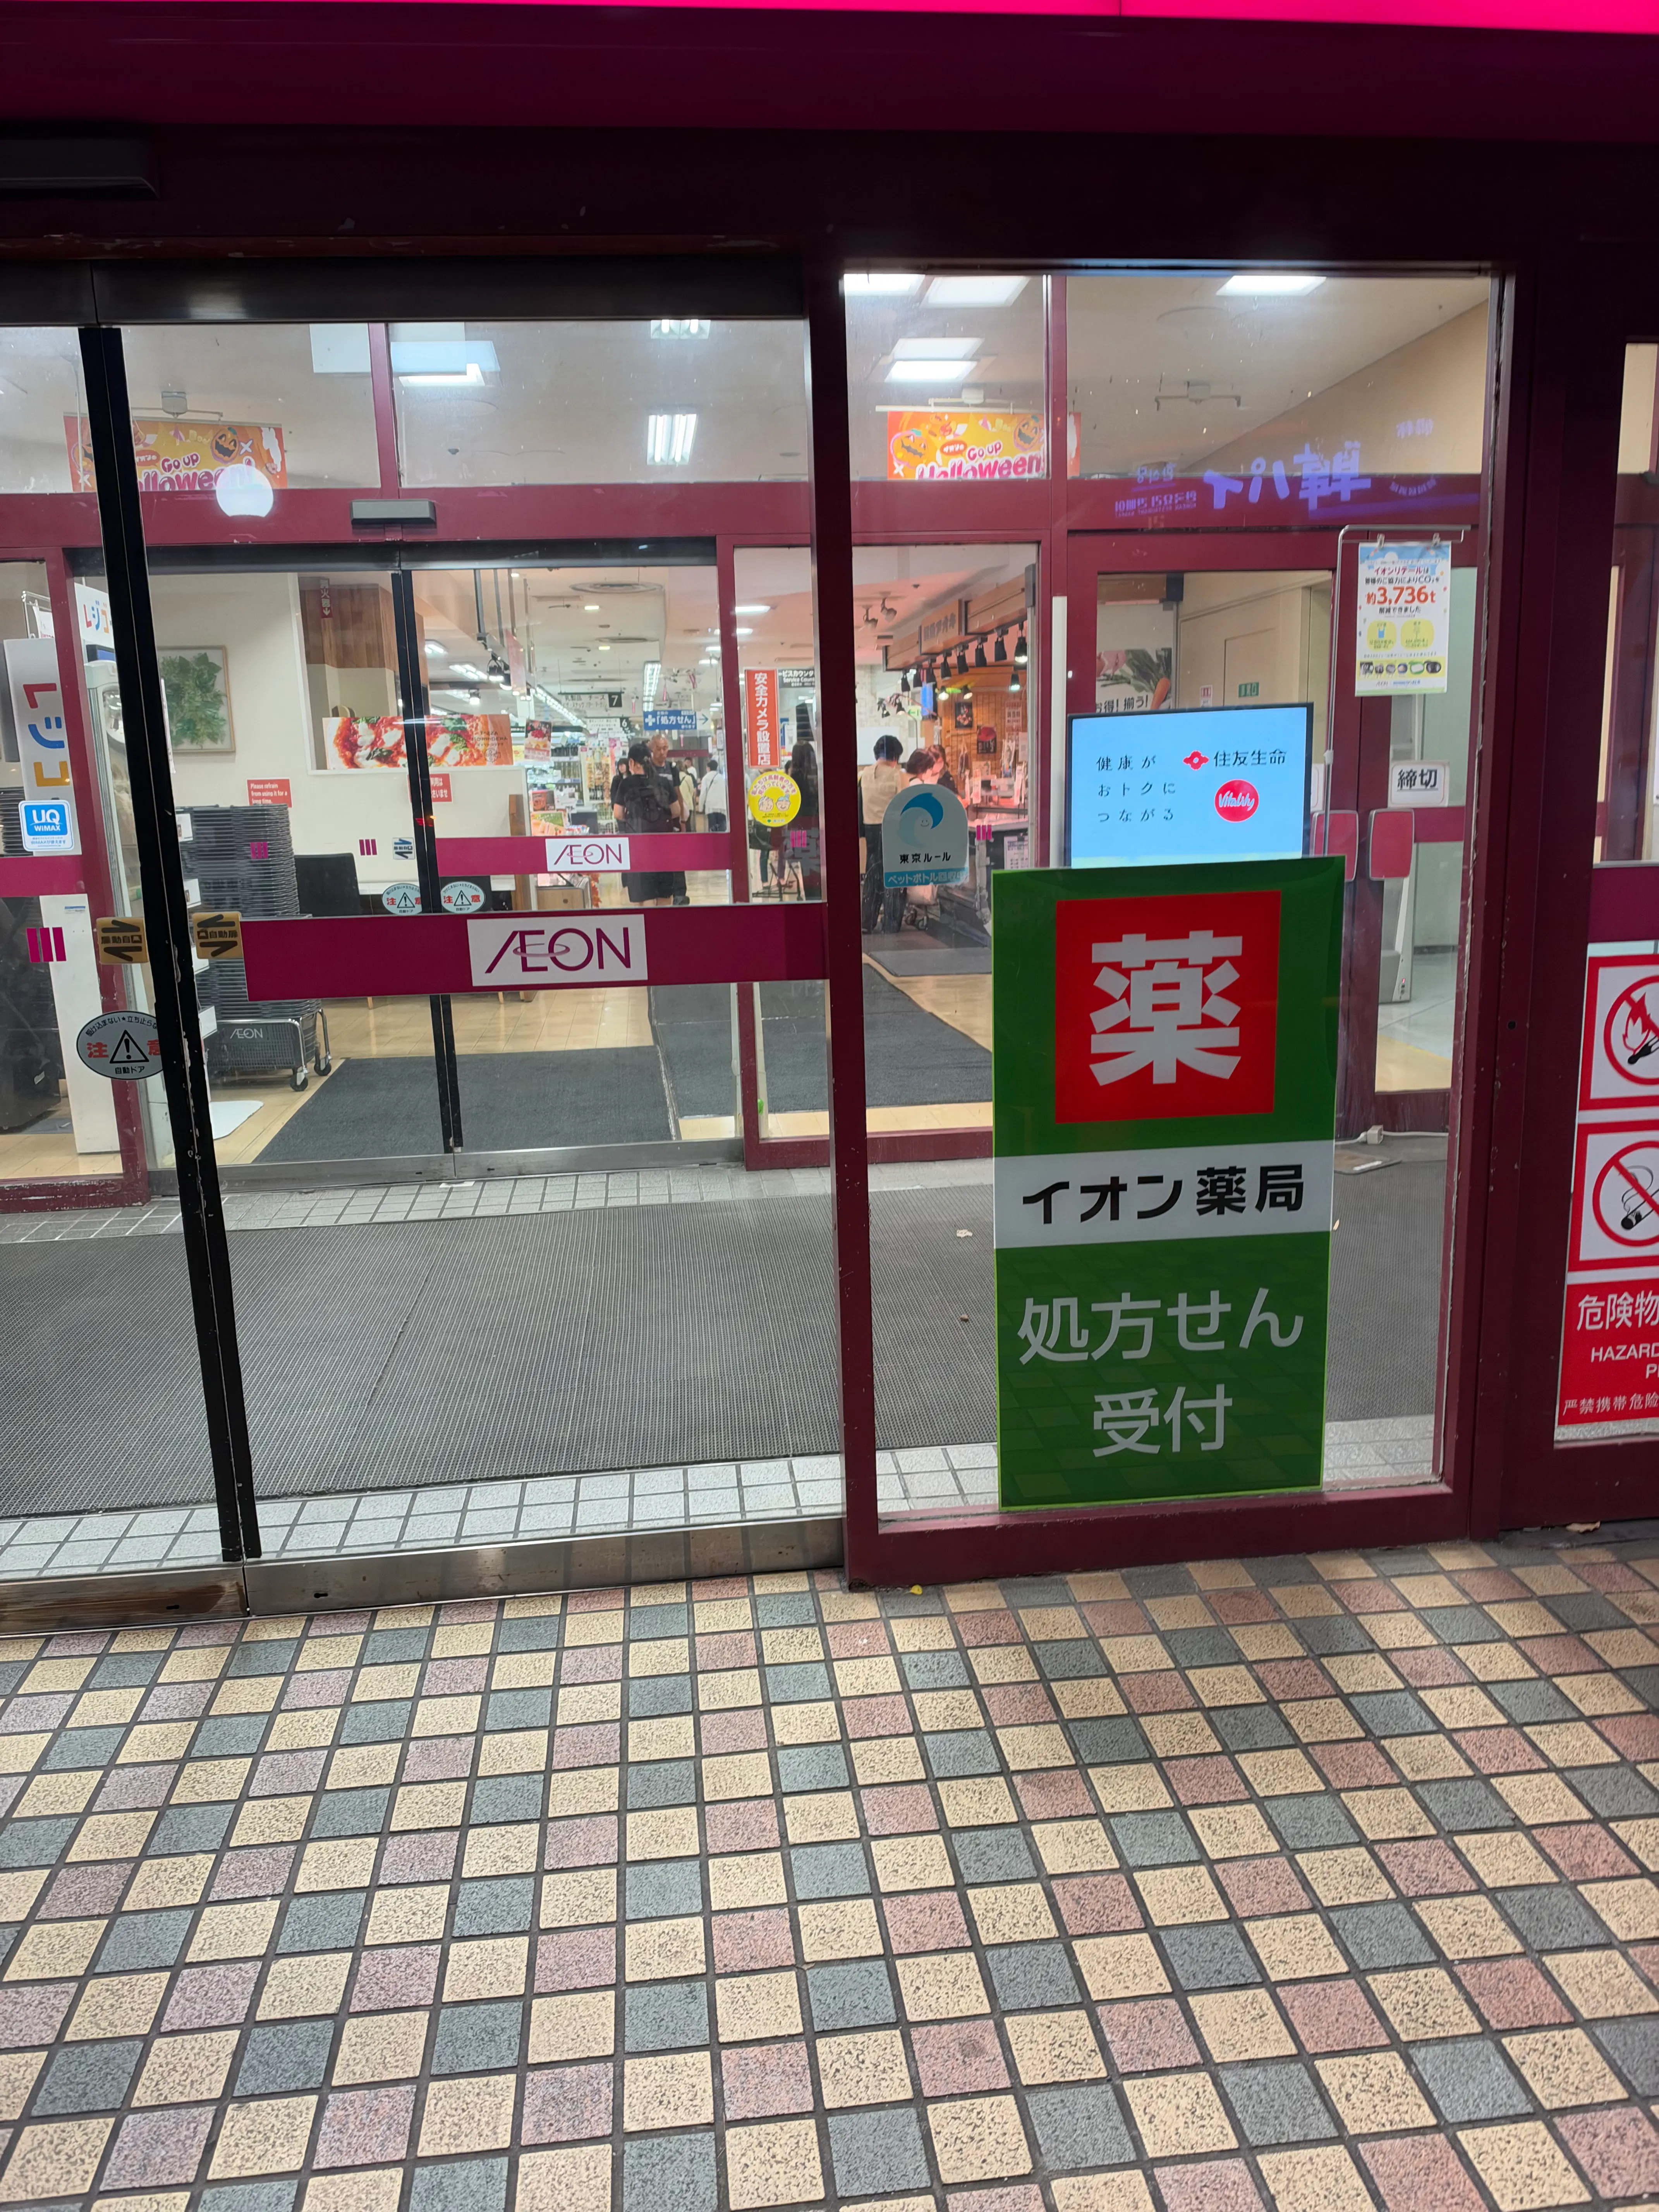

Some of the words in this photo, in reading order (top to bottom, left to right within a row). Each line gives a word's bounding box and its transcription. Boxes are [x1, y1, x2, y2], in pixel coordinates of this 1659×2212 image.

[968, 448, 984, 460] Go
[161, 458, 180, 472] Go
[1374, 567, 1429, 576] イオンリテールは
[611, 695, 618, 706] 7
[622, 719, 628, 727] 6
[754, 673, 771, 766] 安全カメラ設置店
[1096, 754, 1156, 772] 健康が
[1214, 748, 1287, 768] 住友生命
[1397, 768, 1438, 789] 締切
[1098, 781, 1176, 798] おトクに
[1219, 791, 1255, 811] Vitality
[32, 809, 60, 825] UQ
[1098, 808, 1174, 823] つながる
[900, 852, 951, 864] 東京ルール
[1089, 930, 1243, 1085] 薬
[87, 1042, 109, 1058] 注
[115, 1066, 145, 1074] 自動ドア
[1022, 1164, 1304, 1224] イオン薬局
[1577, 1290, 1659, 1331] 危険物
[1017, 1287, 1304, 1366] 処方せん
[1646, 1363, 1659, 1379] P
[1092, 1384, 1232, 1459] 受付
